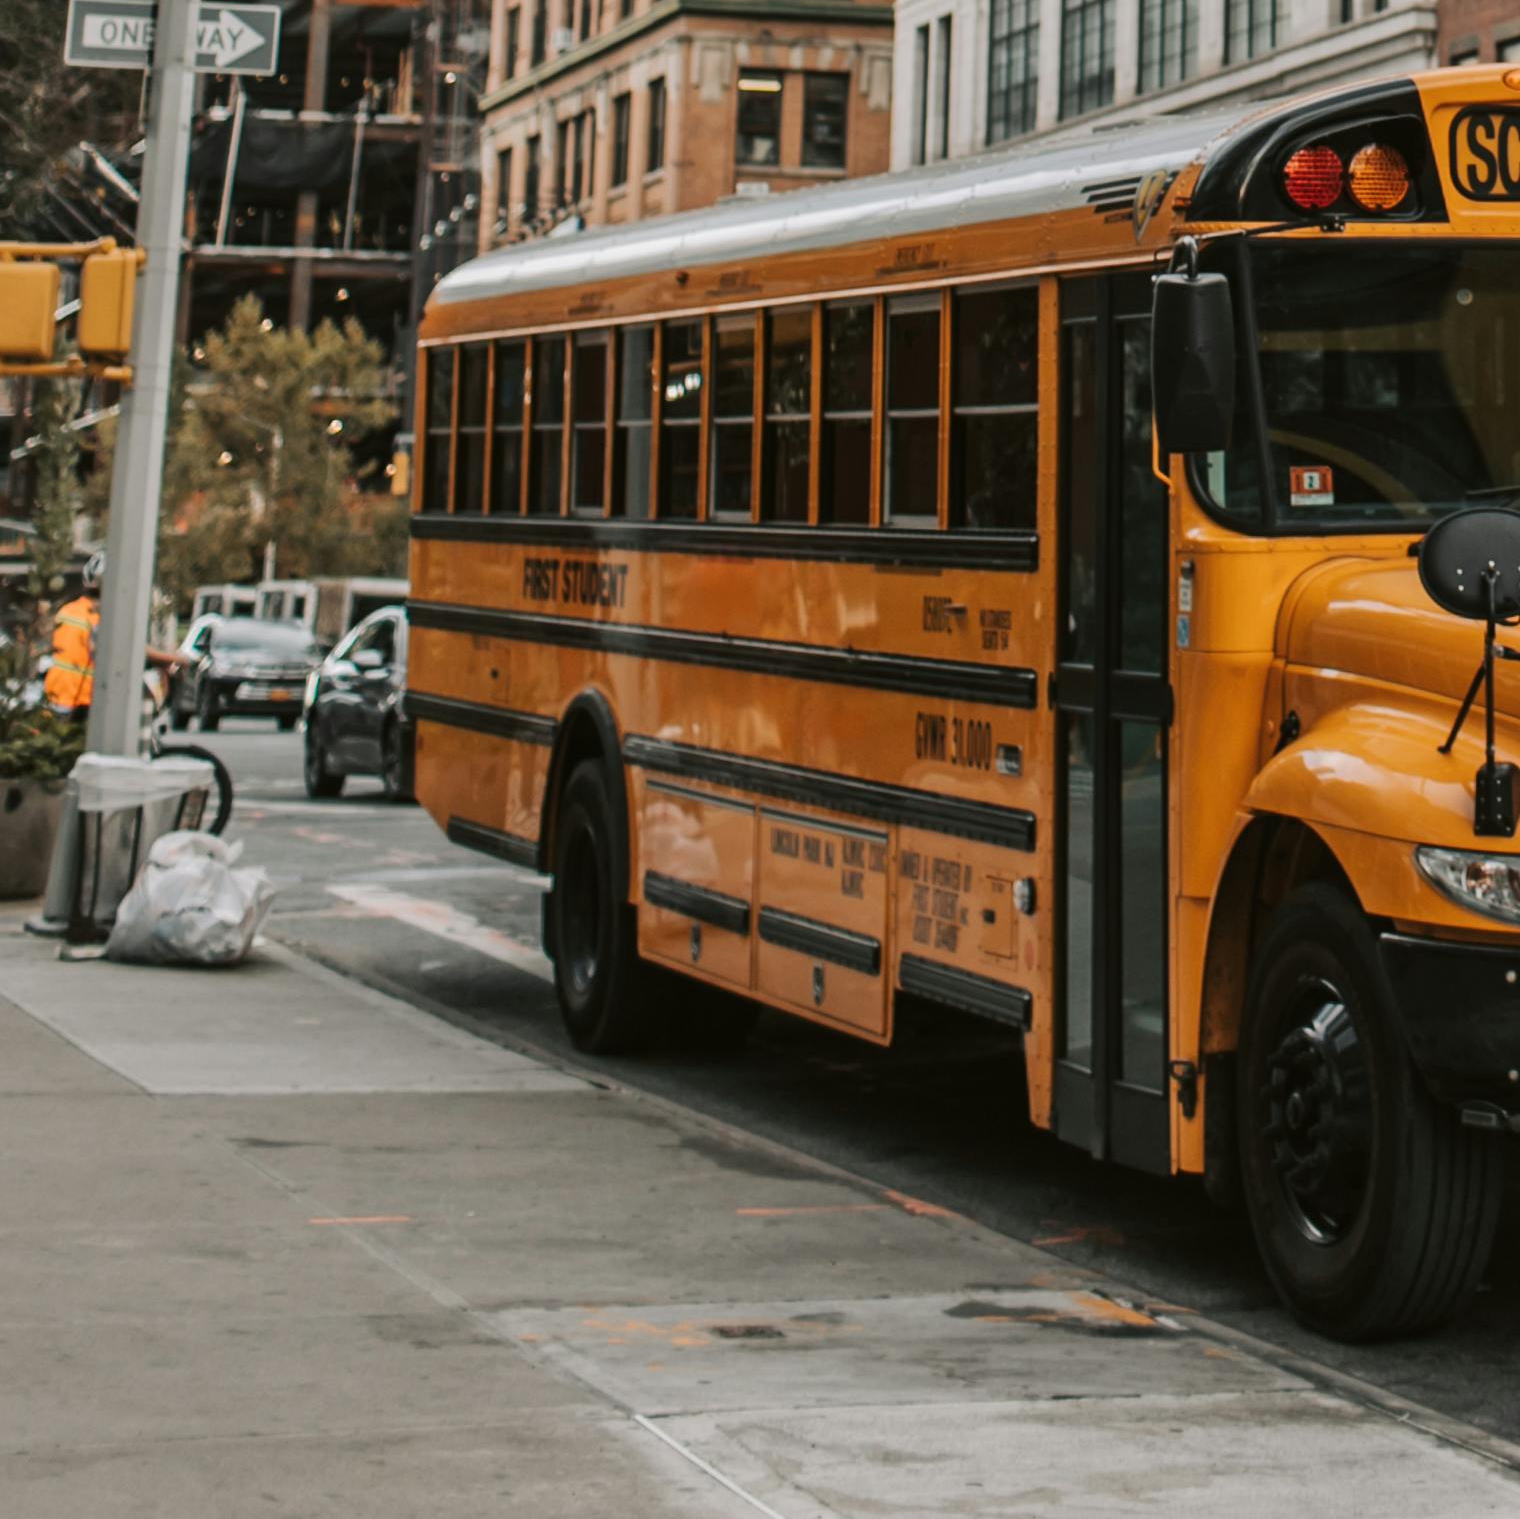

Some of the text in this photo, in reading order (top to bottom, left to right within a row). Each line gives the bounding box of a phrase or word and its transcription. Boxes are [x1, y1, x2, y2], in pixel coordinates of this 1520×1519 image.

[101, 19, 155, 45] ONE
[523, 558, 628, 609] FIRST STUDENT
